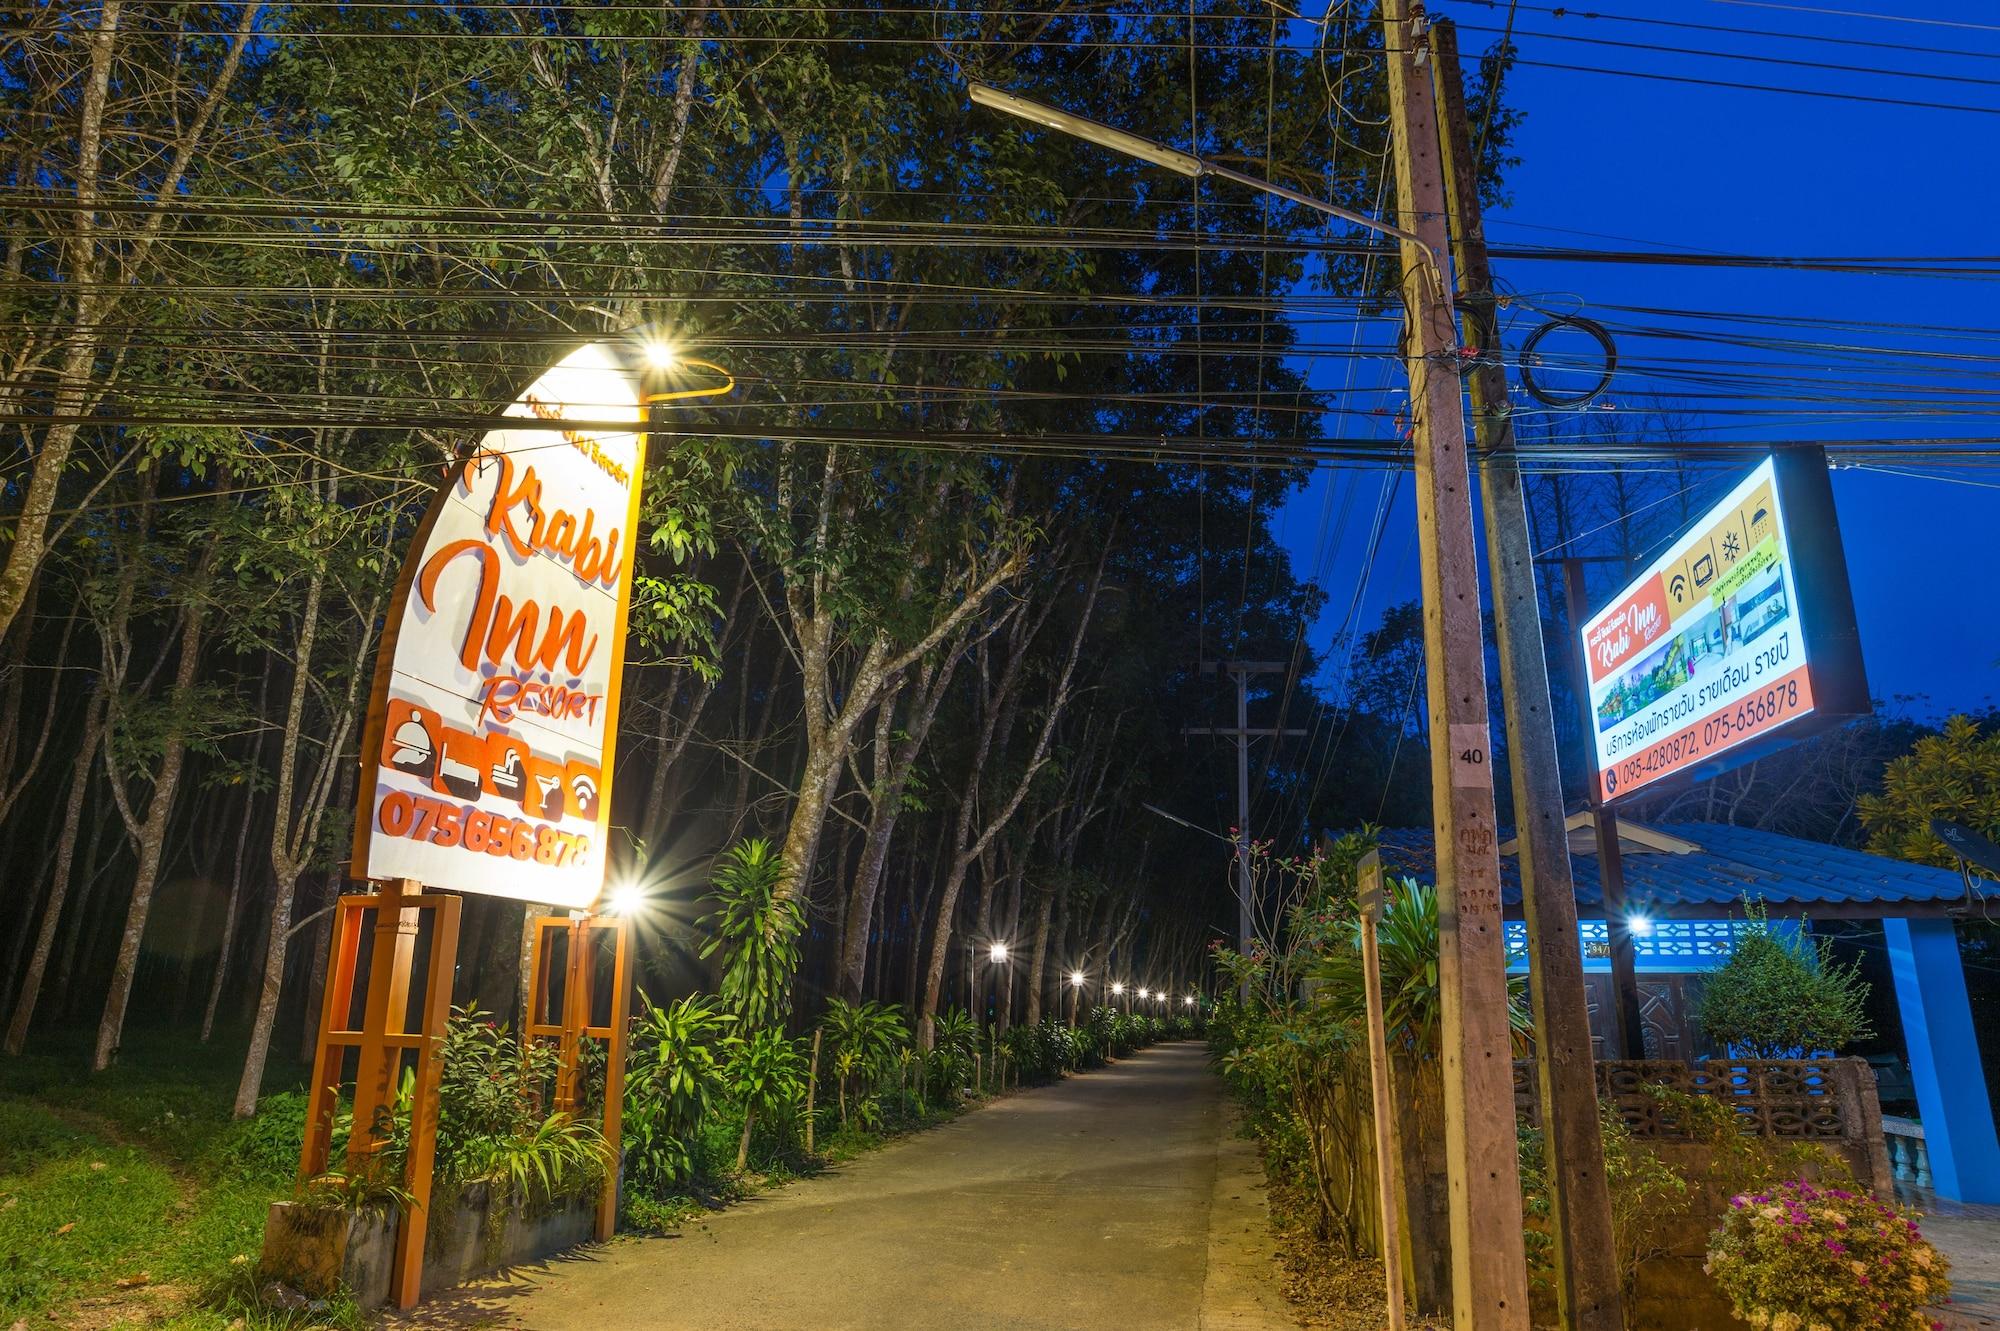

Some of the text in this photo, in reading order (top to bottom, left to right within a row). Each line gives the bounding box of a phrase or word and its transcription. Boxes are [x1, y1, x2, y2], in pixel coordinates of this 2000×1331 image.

[463, 449, 623, 584] Krabi
[418, 539, 598, 677] Inn
[1597, 602, 1657, 667] Krabi Inn
[1605, 631, 1789, 757] บริการห้องพักรายวัน รายเดือน รายปี
[1622, 679, 1798, 785] 095-4280872, 075-656878
[1460, 748, 1483, 765] 40
